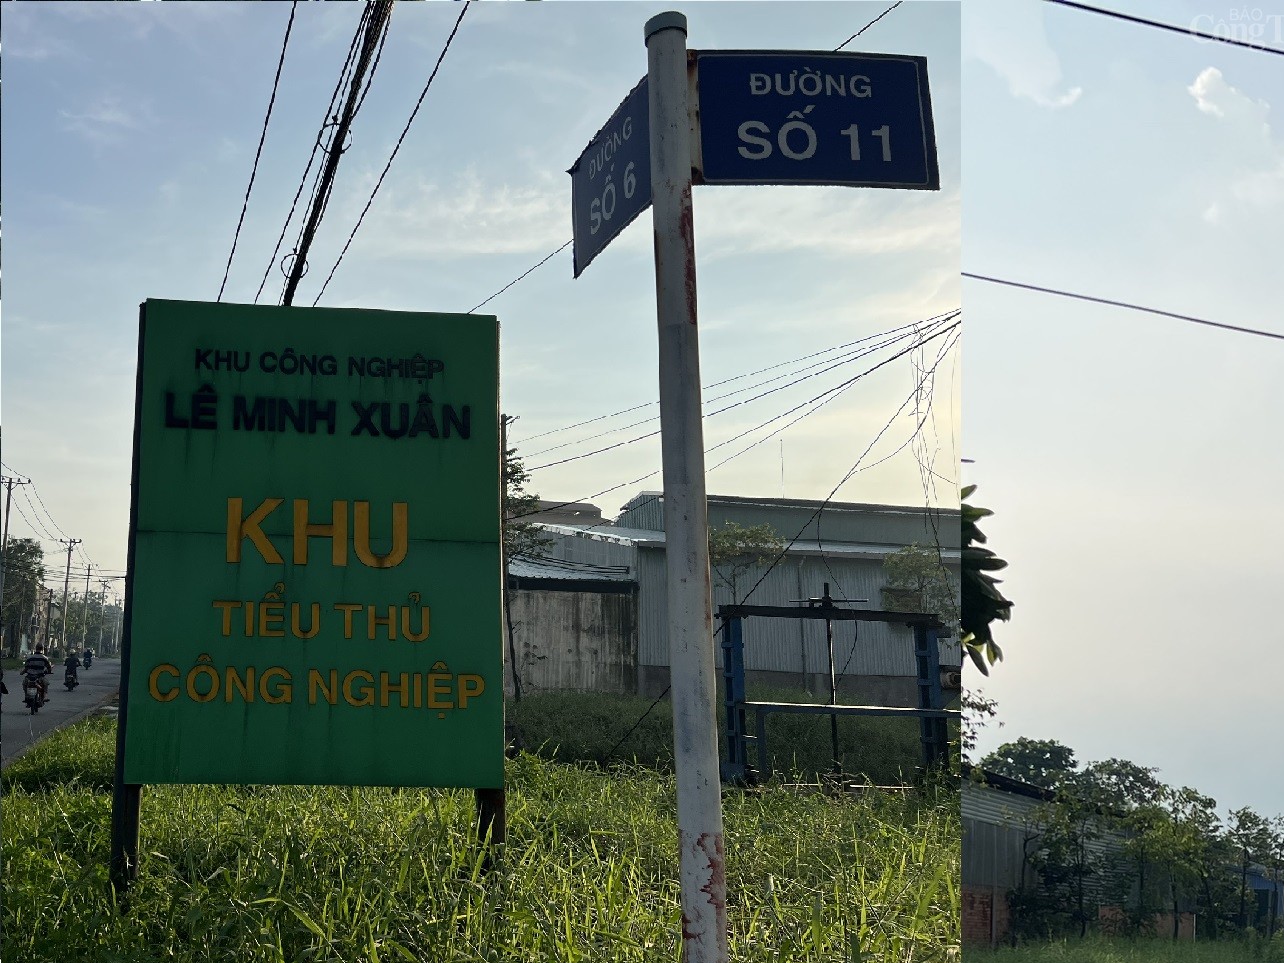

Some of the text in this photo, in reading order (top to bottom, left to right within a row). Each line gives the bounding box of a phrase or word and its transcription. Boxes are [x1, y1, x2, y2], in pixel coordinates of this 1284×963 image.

[749, 66, 872, 98] ĐƯỜNG
[736, 104, 893, 162] SỐ 11
[590, 161, 637, 235] SỐ 6
[194, 347, 445, 385] KHU CÔNG NGHIỆP
[164, 385, 472, 440] LÊ MINH XUÂN
[225, 496, 409, 569] KHU
[212, 581, 431, 643] TIỂU THỦ
[148, 653, 486, 719] CÔNG NGHIỆP
